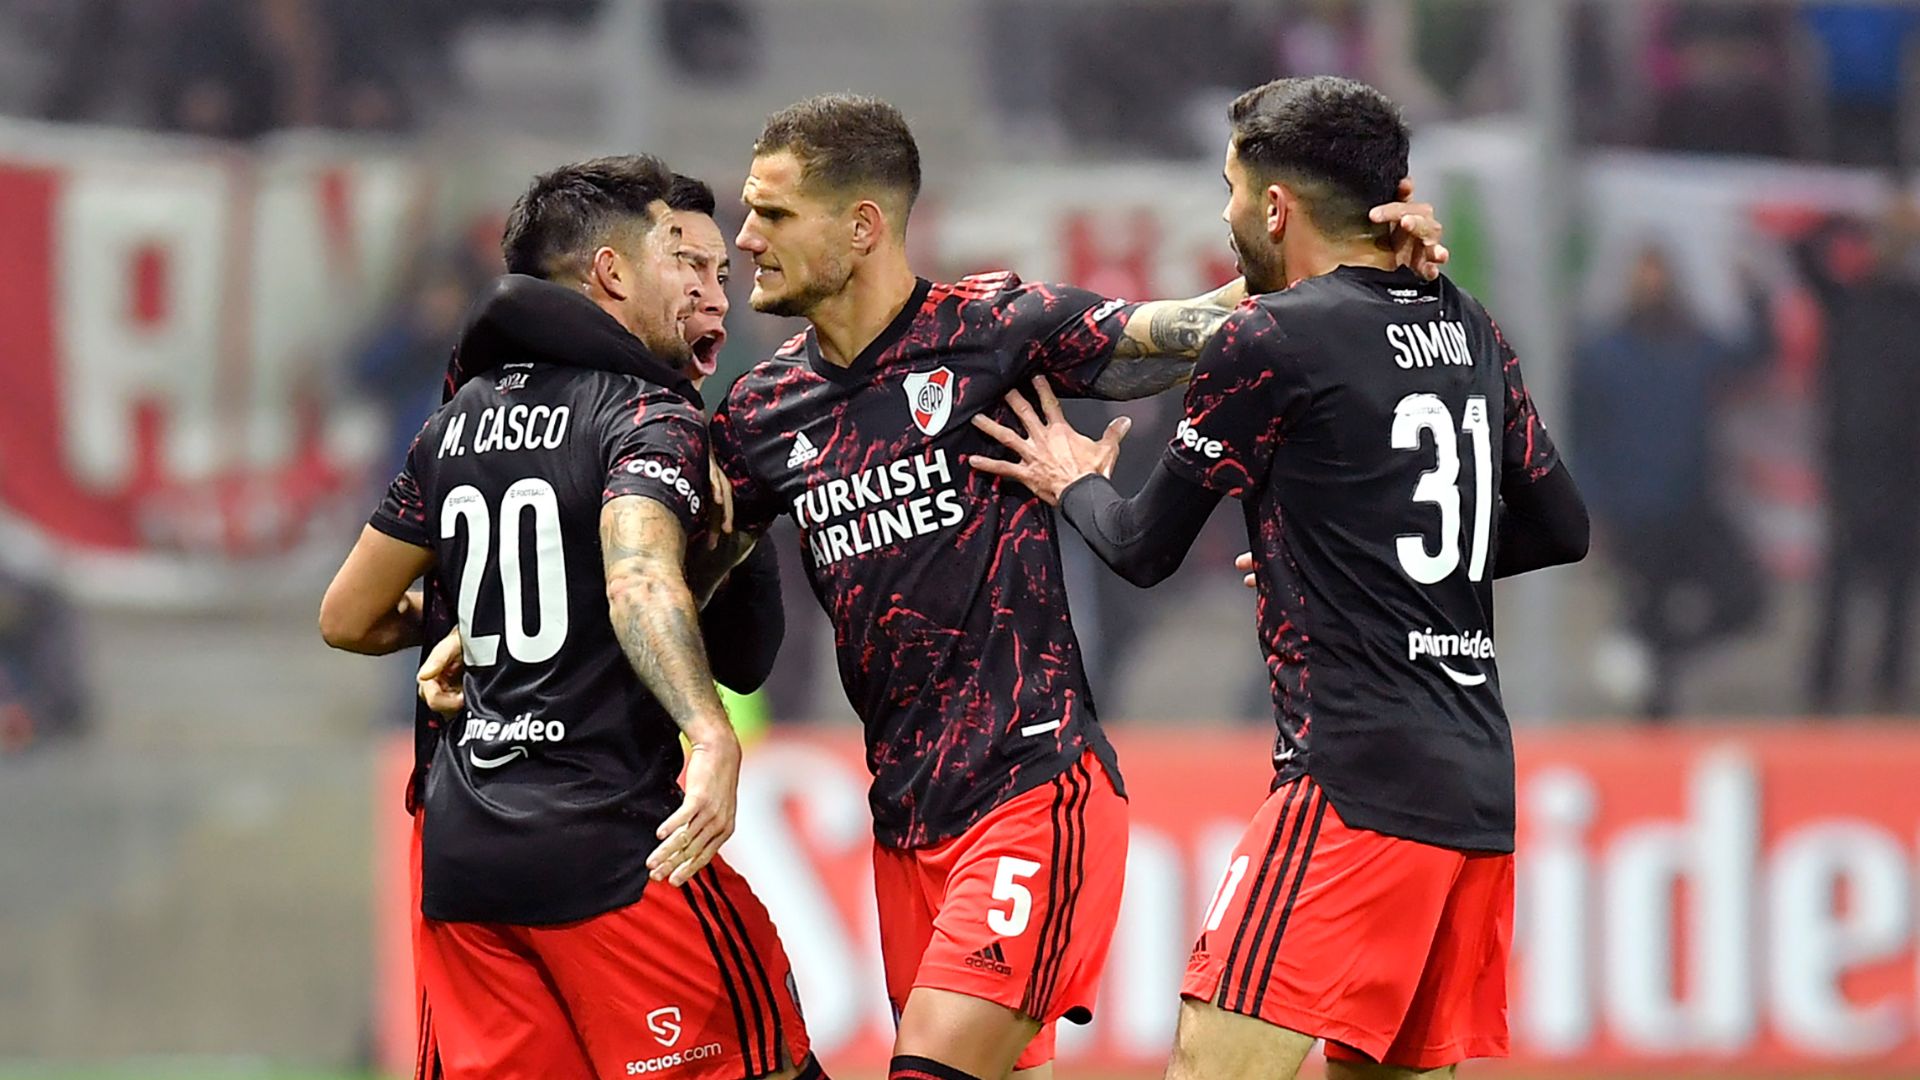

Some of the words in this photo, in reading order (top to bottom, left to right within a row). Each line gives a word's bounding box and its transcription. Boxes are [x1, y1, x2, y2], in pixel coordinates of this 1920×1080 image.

[1386, 311, 1474, 369] SIMÓN
[437, 412, 466, 459] M.
[473, 405, 570, 454] CASCO
[627, 458, 701, 514] codere
[793, 448, 952, 529] TURKISH
[1391, 392, 1493, 585] 31
[809, 489, 964, 568] AIRLINES
[440, 477, 569, 667] 20
[986, 855, 1042, 937] 5
[965, 957, 1012, 976] adidas
[625, 1042, 722, 1075] SOCIOS.com
